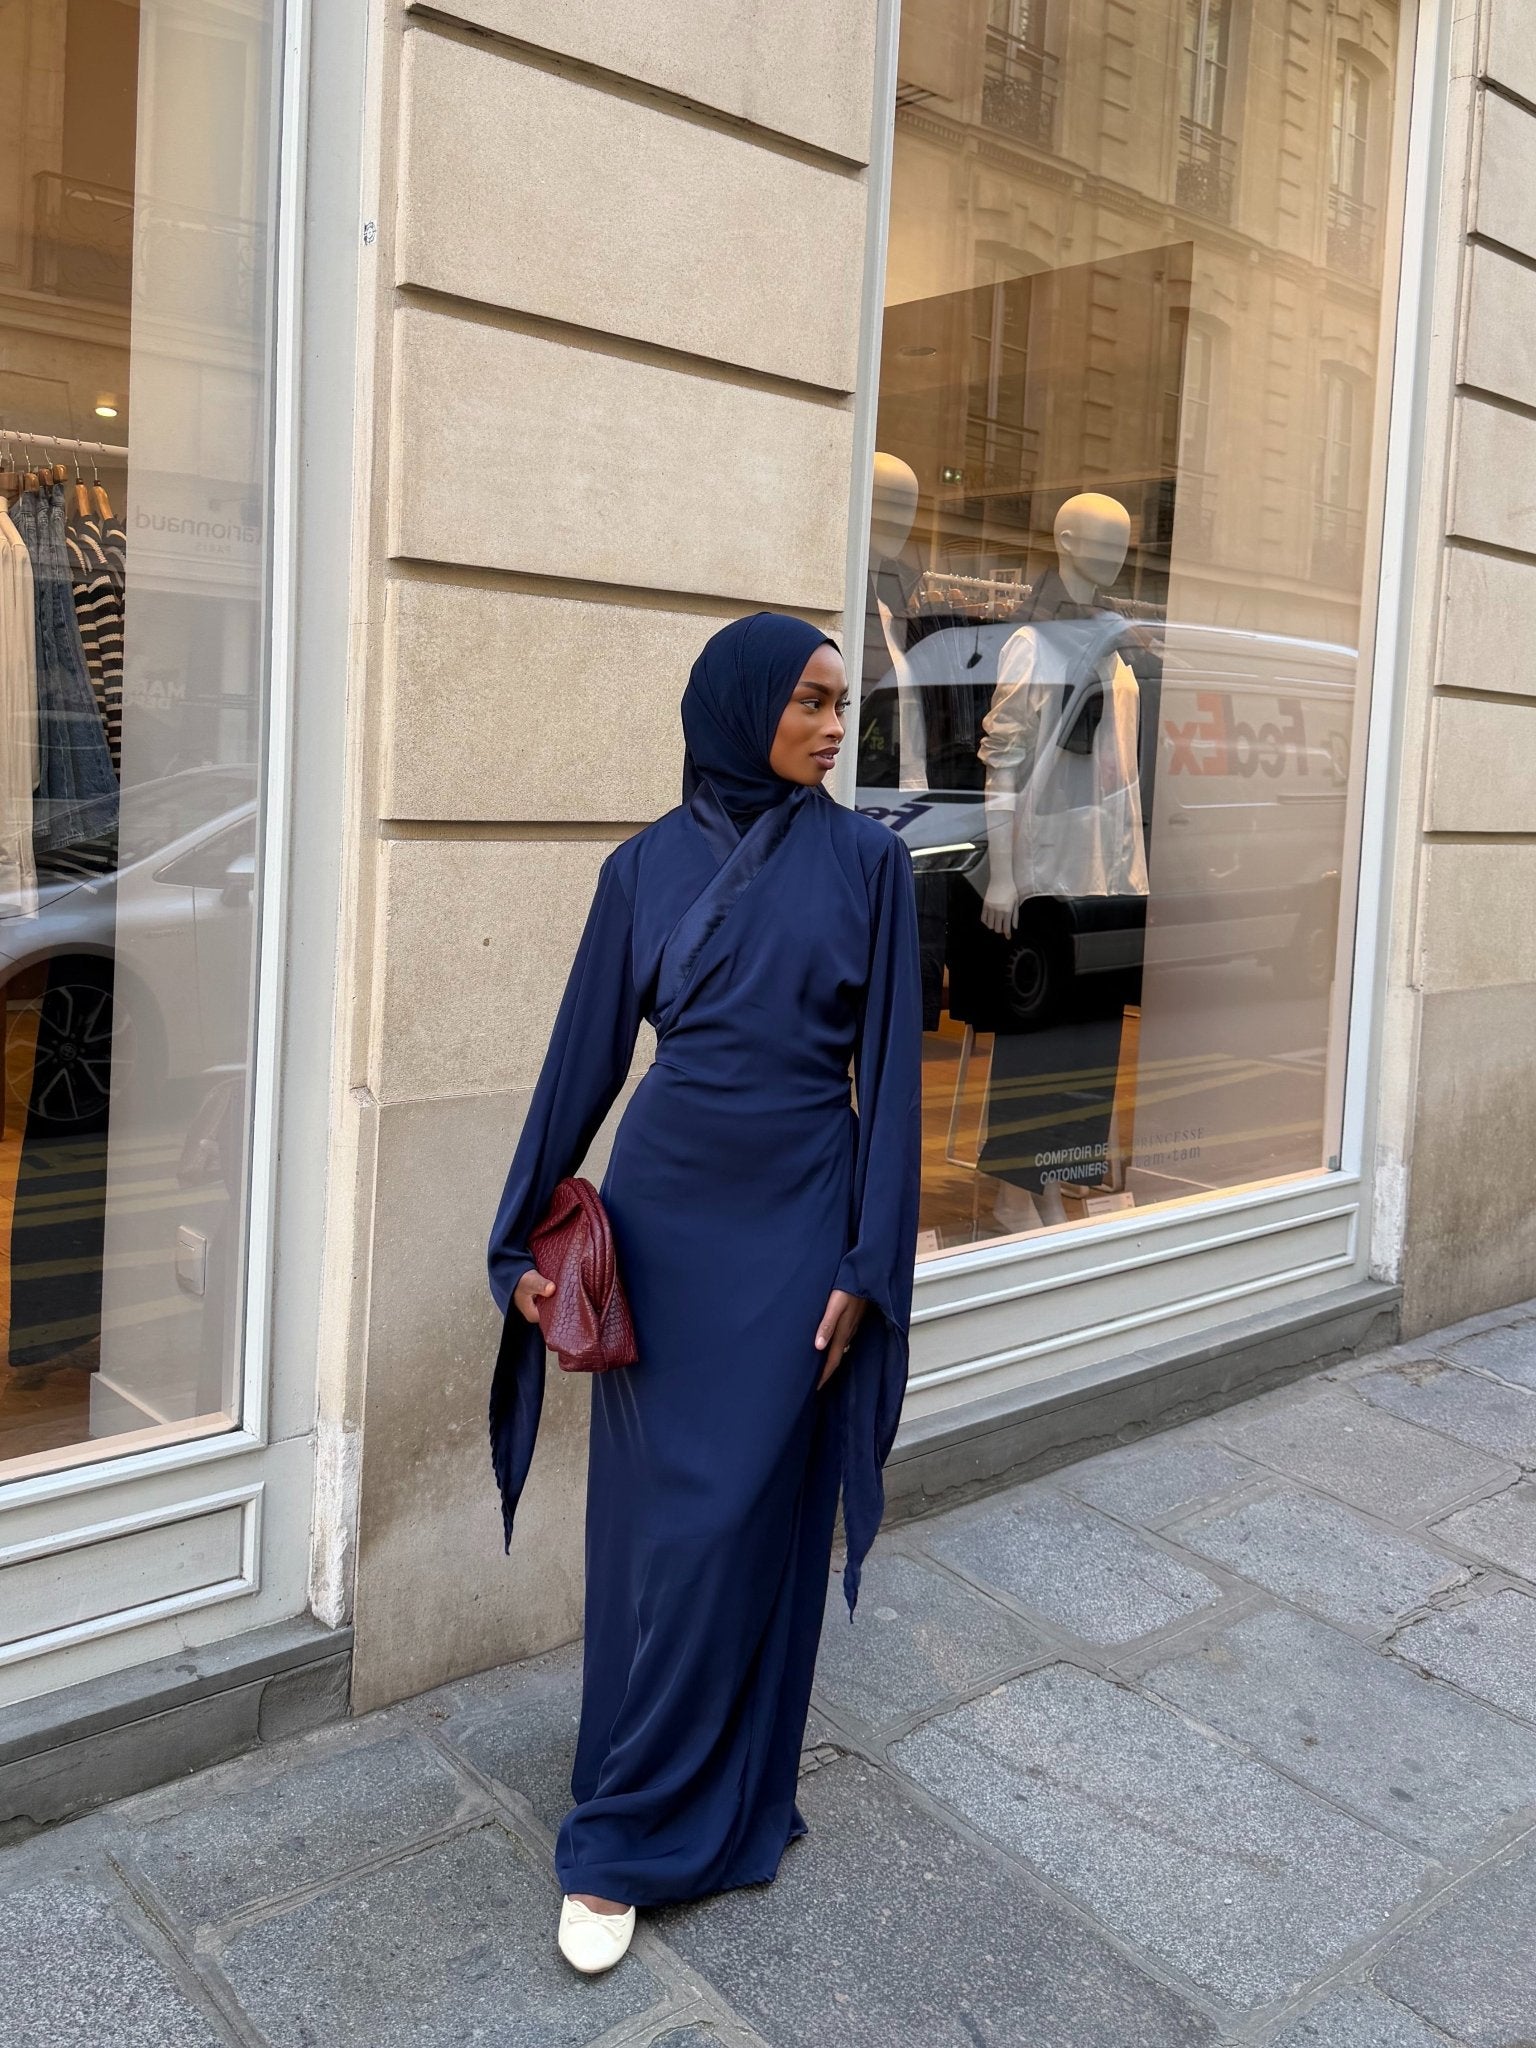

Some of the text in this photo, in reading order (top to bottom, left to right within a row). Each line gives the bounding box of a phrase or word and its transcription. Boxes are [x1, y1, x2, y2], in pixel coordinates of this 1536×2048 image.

[1035, 1142, 1109, 1167] COMPTOIR DE
[1040, 1161, 1109, 1185] COTONNIERS
